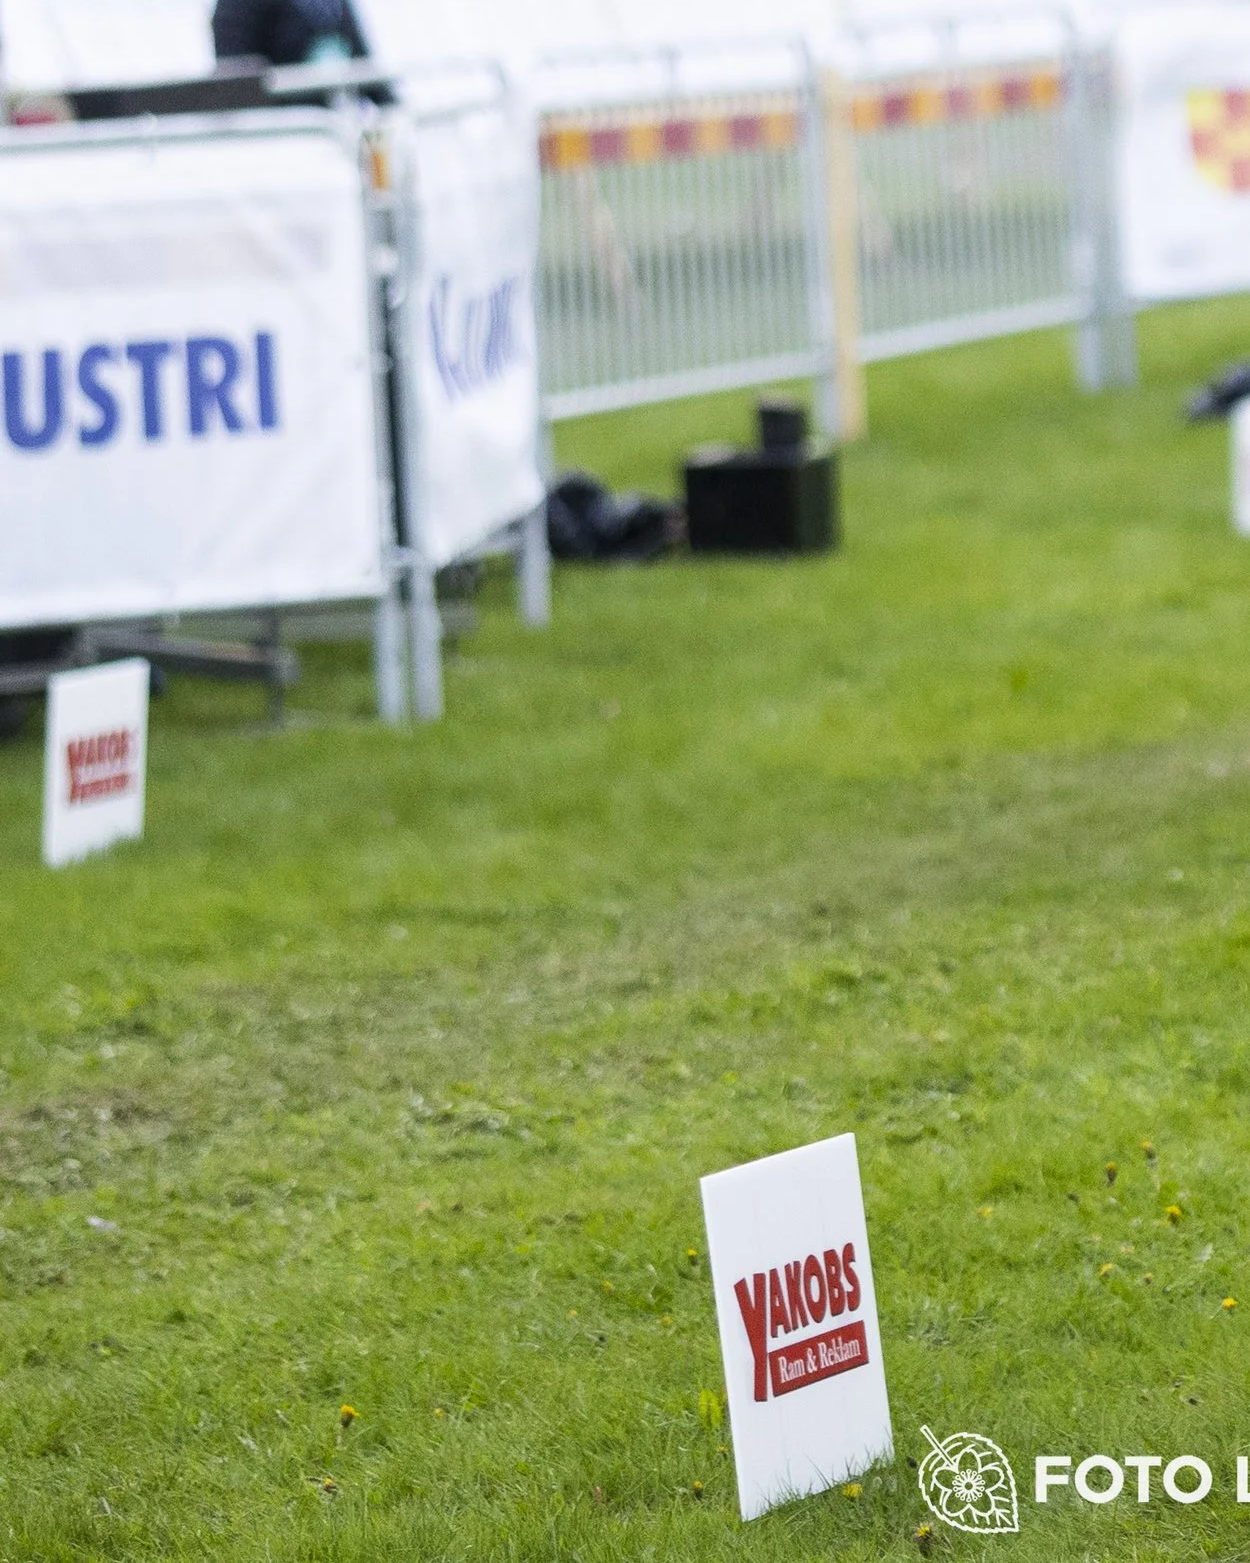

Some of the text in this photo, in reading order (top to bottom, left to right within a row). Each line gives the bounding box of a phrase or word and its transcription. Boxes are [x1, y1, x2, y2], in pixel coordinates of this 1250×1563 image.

[2, 331, 278, 452] USTRI
[734, 1242, 861, 1403] YAKOBS
[777, 1336, 862, 1384] Ram & Reklam
